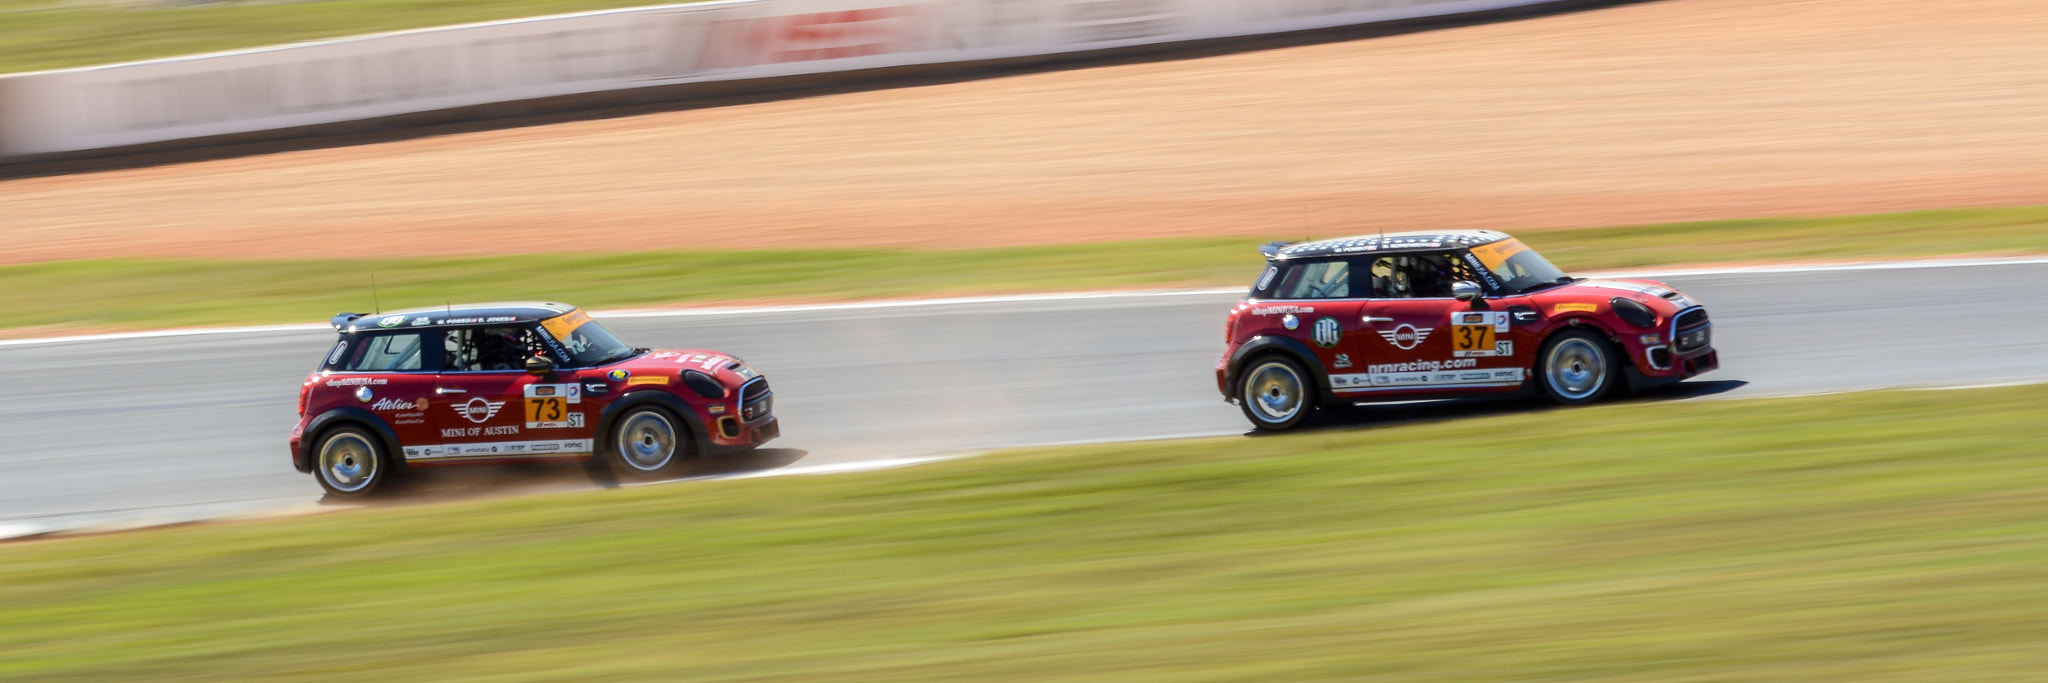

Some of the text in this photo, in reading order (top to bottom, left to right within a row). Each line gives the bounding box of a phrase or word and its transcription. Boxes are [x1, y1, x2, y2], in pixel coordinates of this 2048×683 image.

[1459, 326, 1488, 349] 37
[1497, 342, 1510, 355] ST
[1368, 359, 1476, 374] nrnracing.com
[371, 397, 419, 411] Atelier
[531, 398, 560, 421] 73
[569, 414, 581, 426] ST
[441, 425, 519, 438] MINI OF AUSTIN
